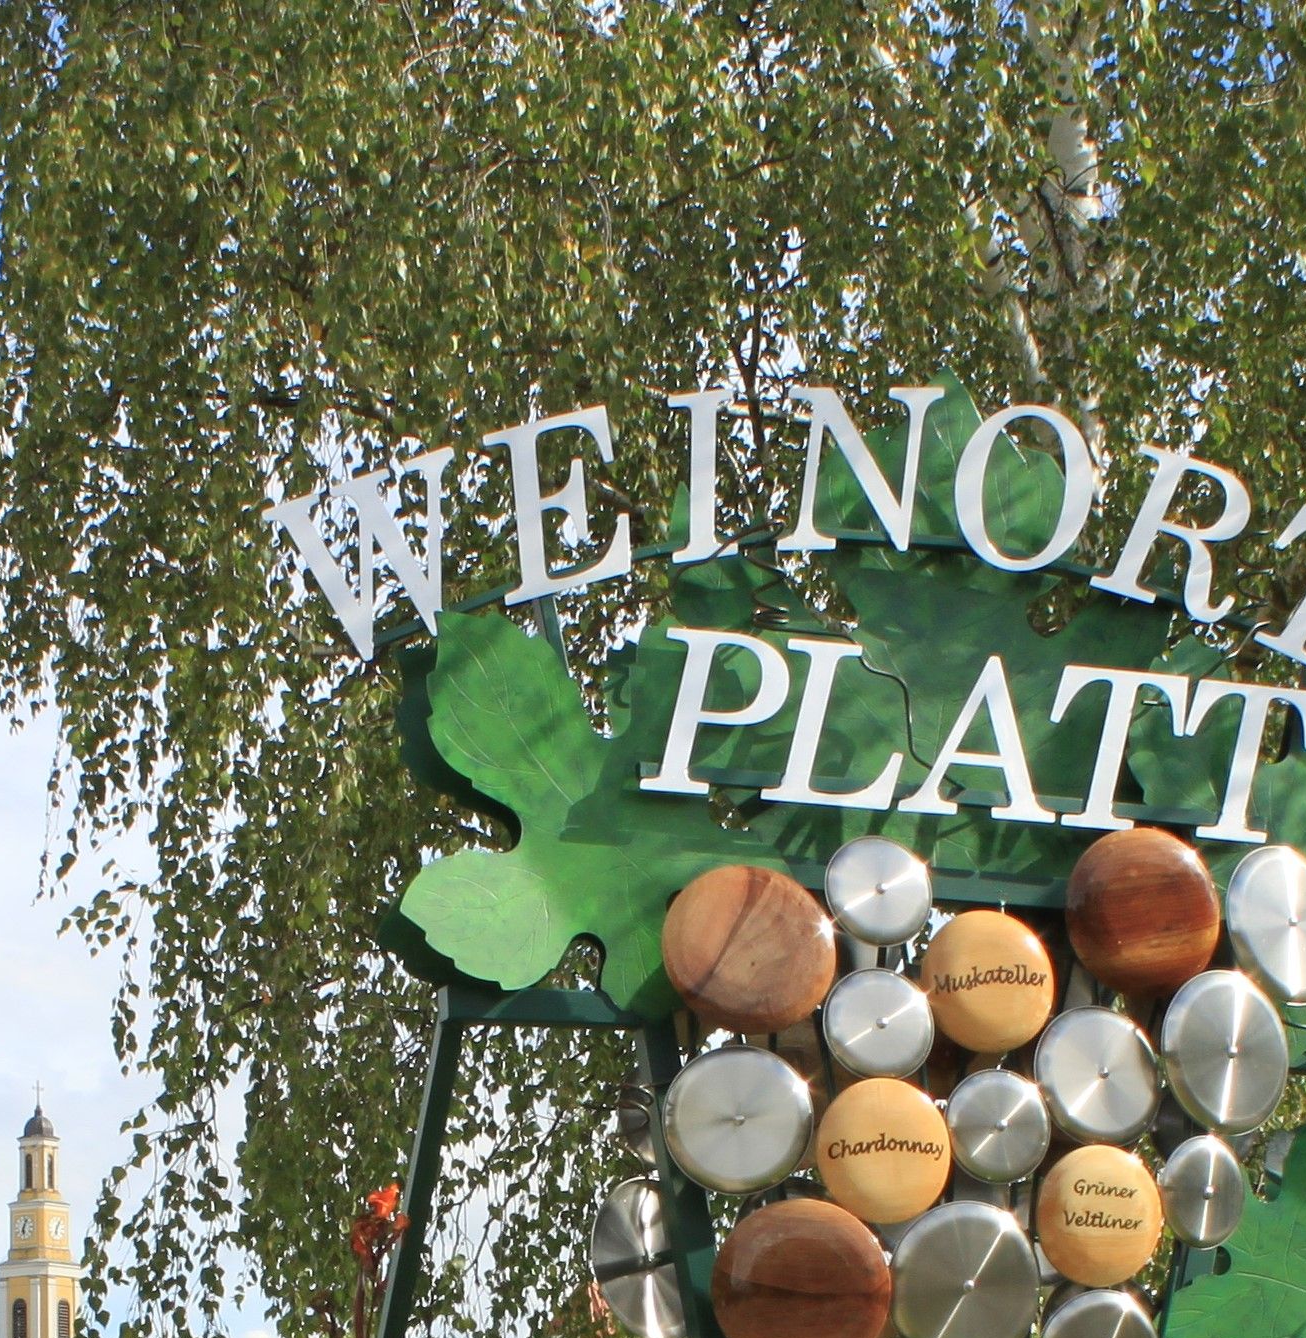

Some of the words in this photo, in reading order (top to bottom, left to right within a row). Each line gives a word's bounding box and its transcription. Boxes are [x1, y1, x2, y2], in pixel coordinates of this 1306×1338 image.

[933, 964, 1048, 996] Muskateller
[828, 1132, 944, 1161] Chardonnay
[1073, 1178, 1138, 1199] Grüner
[1062, 1209, 1143, 1231] Veltliner
